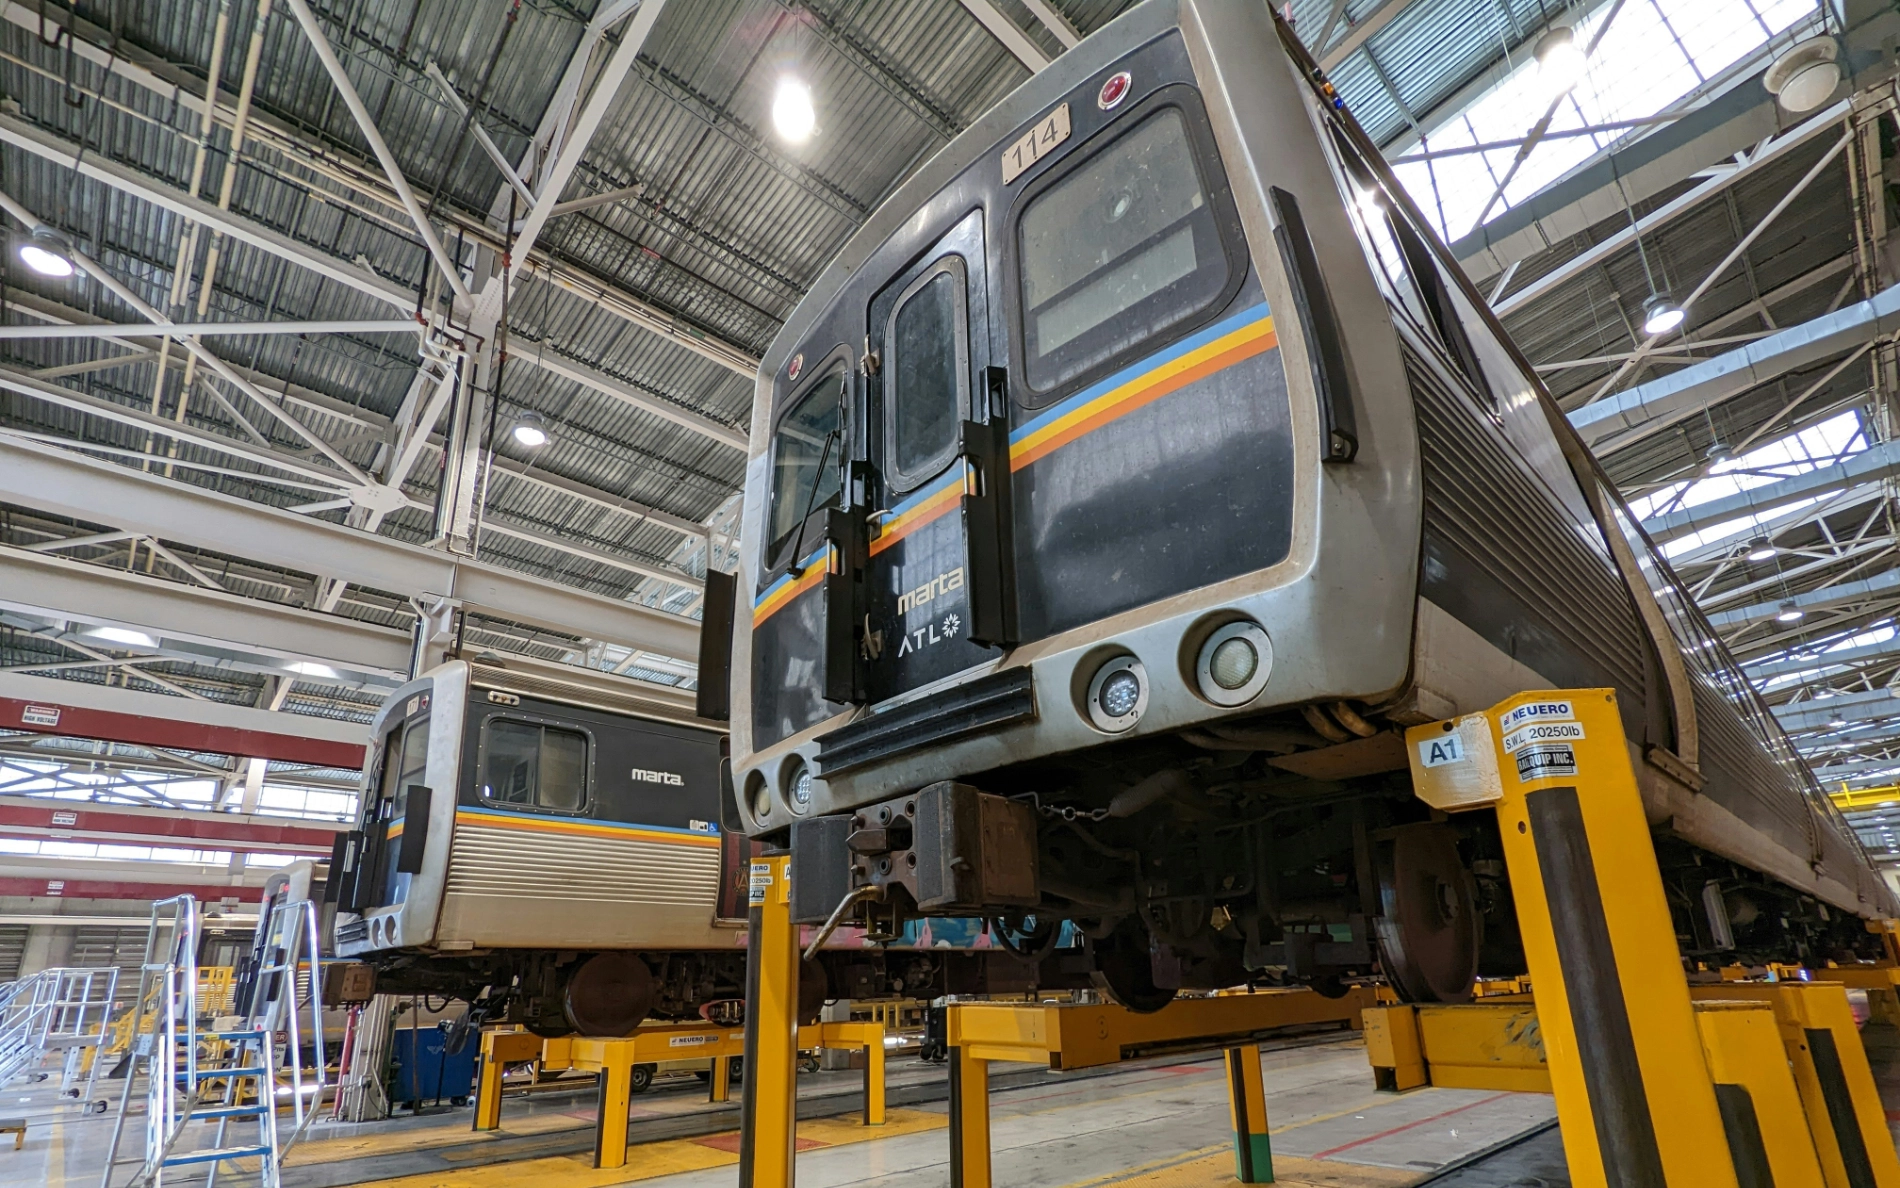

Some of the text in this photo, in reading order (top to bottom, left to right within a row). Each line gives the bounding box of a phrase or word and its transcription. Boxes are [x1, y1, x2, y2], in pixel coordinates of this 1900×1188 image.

[1012, 118, 1058, 168] 114
[898, 567, 964, 616] marta
[898, 624, 941, 657] ATL
[1512, 704, 1569, 721] NEUERO
[1528, 726, 1580, 739] 20250lb
[1430, 739, 1457, 763] A1
[1552, 753, 1573, 764] INC.
